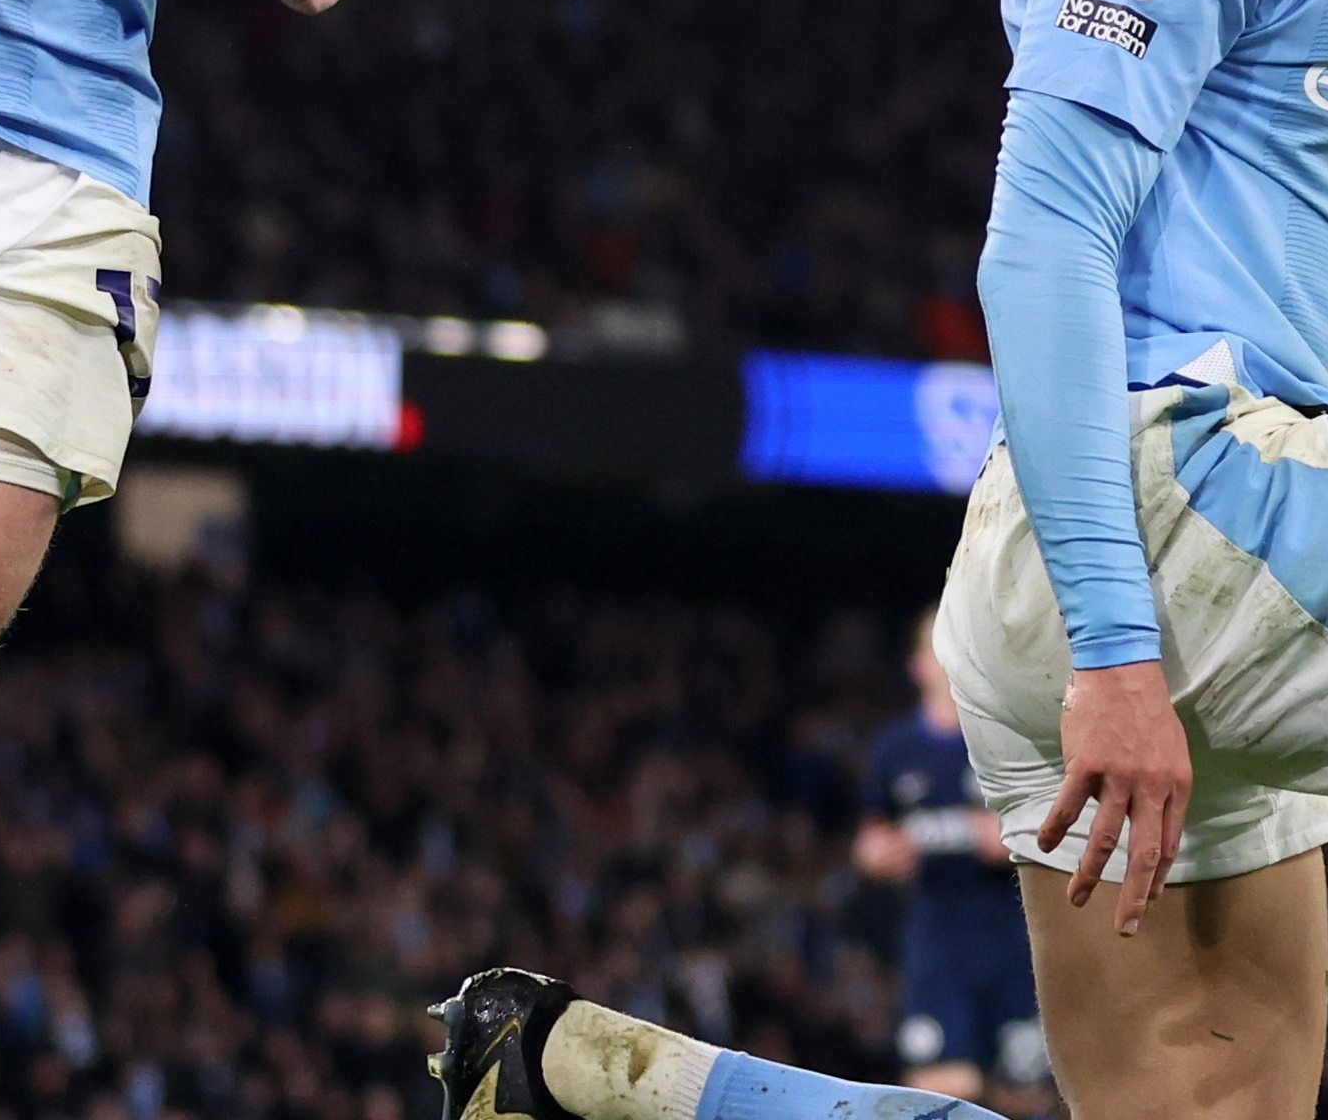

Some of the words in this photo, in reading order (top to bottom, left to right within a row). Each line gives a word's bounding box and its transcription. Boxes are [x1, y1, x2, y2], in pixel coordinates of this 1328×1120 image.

[1056, 8, 1088, 32] for
[1085, 21, 1147, 59] racism
[1094, 5, 1146, 38] room
